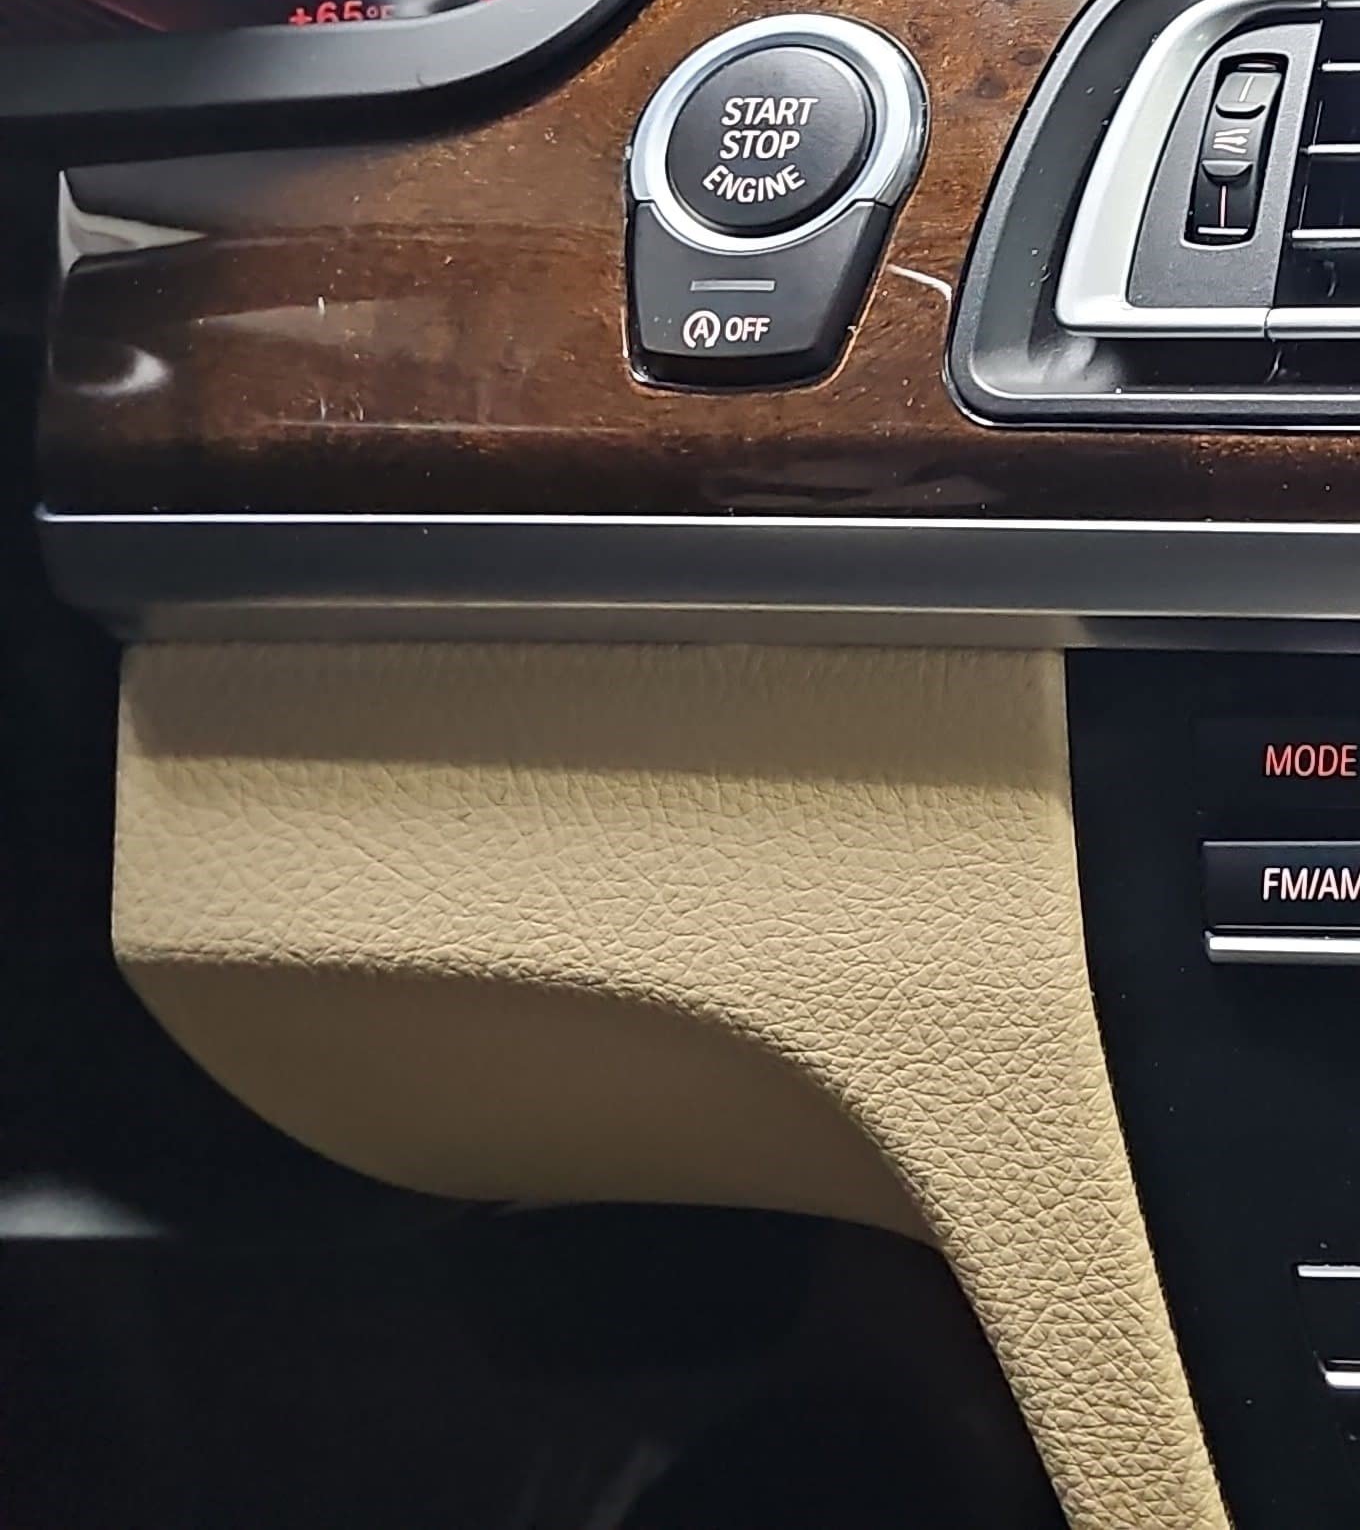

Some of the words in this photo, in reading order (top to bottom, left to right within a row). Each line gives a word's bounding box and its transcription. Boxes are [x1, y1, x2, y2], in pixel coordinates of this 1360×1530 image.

[721, 97, 819, 127] START
[719, 129, 801, 161] STOP
[701, 163, 806, 203] ENGINE
[725, 316, 772, 343] OFF
[1264, 744, 1358, 777] MODE
